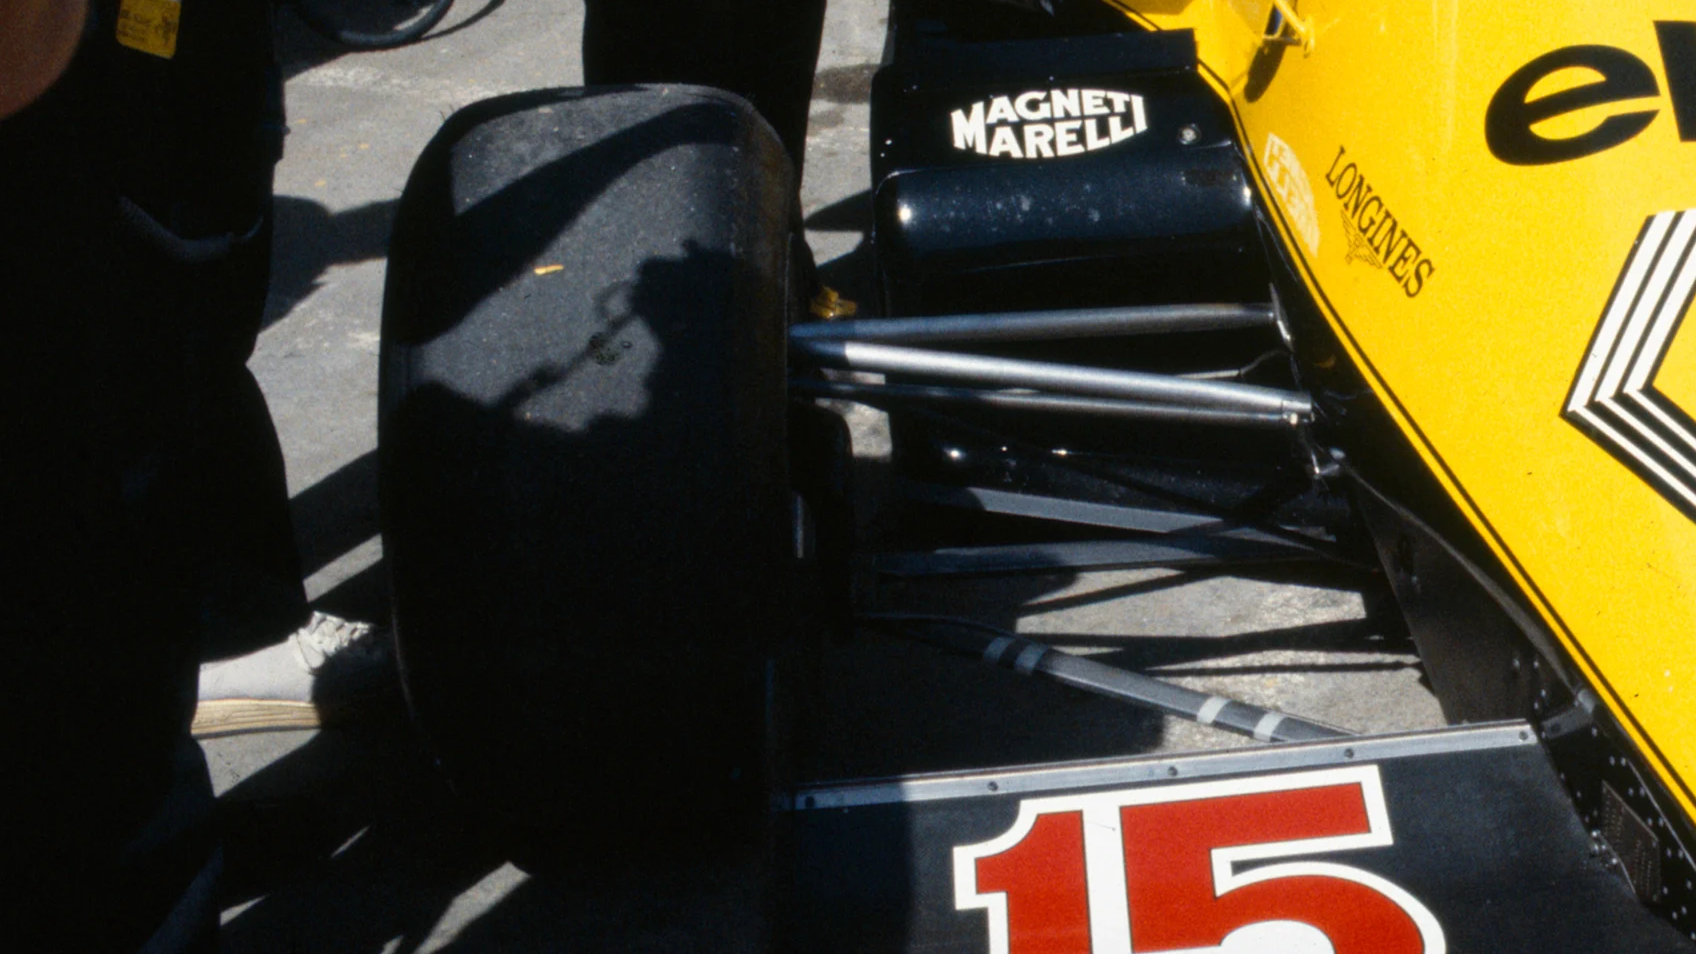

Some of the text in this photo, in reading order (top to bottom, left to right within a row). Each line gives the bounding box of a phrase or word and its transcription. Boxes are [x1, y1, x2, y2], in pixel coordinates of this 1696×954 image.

[950, 89, 1148, 131] MAGNETI
[950, 112, 1148, 159] MARELLI
[1325, 144, 1436, 299] LONGINES
[953, 764, 1447, 954] 15
